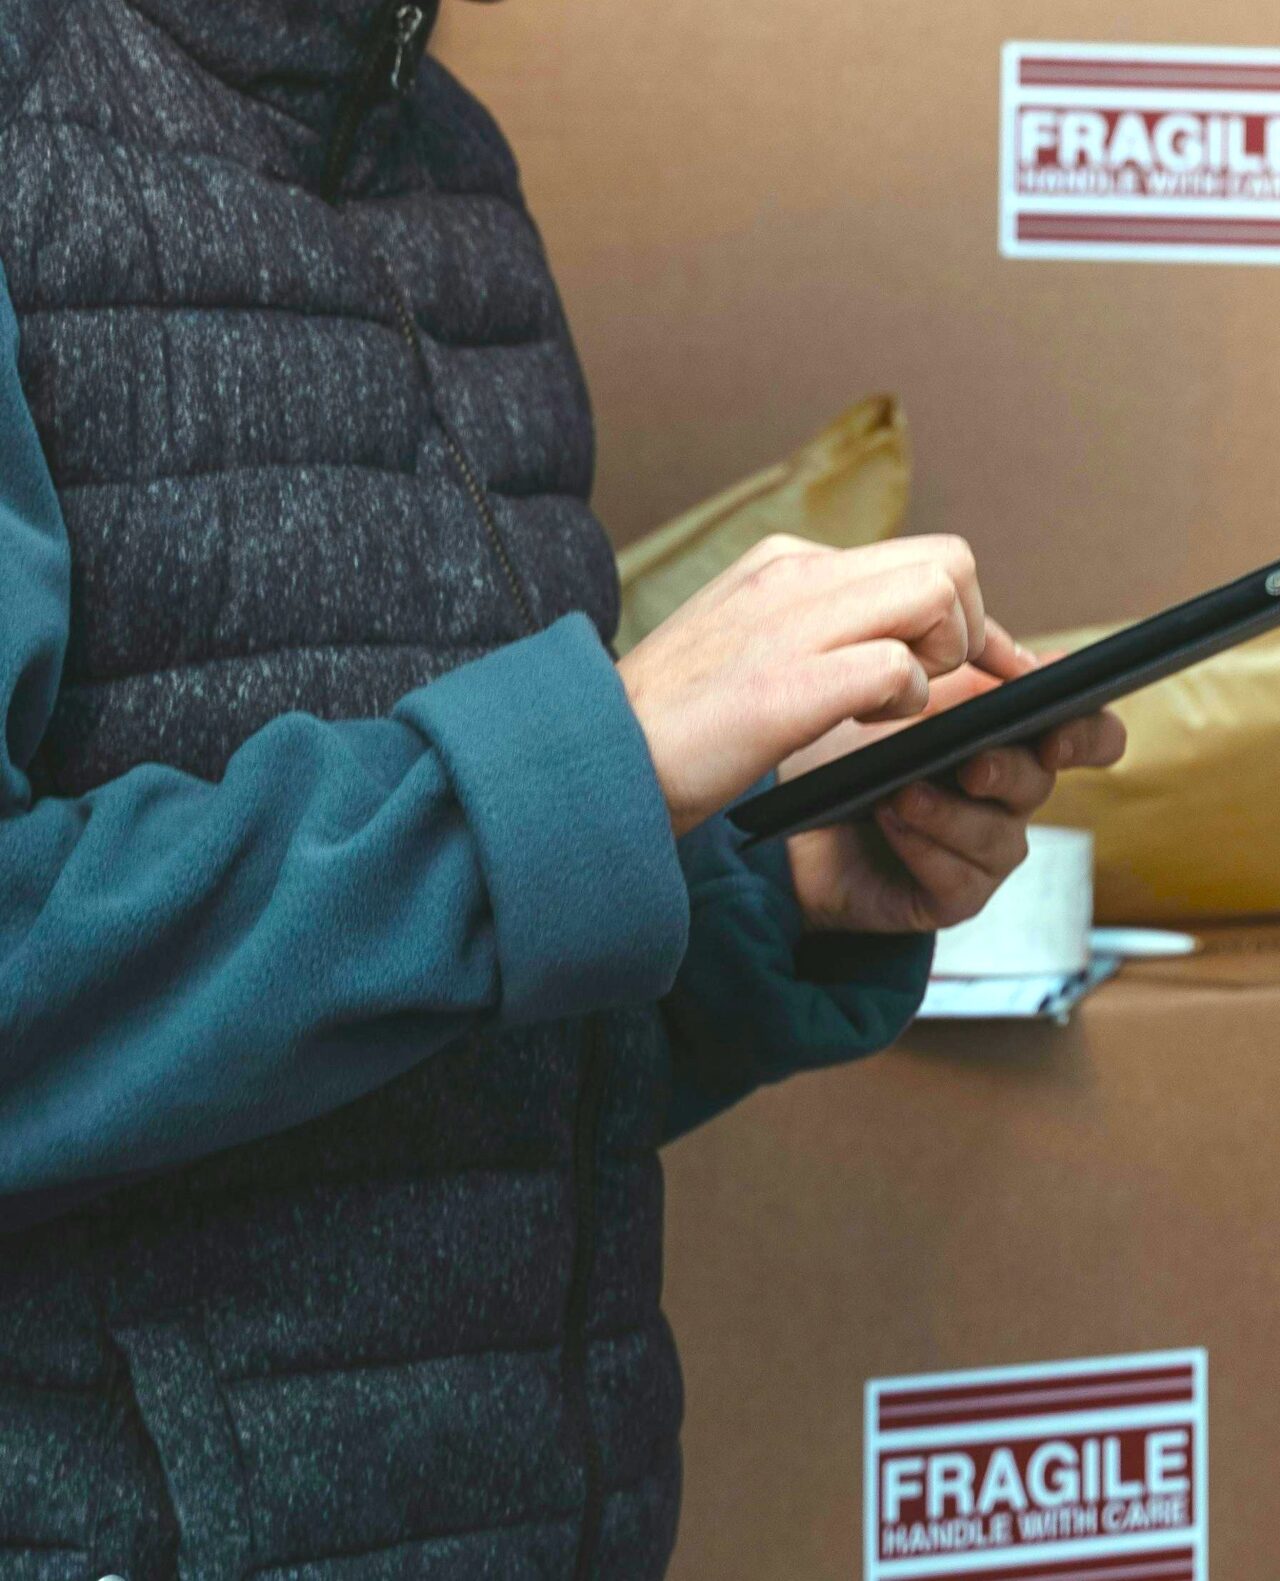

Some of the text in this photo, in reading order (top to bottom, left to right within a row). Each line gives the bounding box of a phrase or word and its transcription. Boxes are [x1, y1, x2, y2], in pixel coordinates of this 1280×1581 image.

[881, 1430, 1190, 1524] FRAGILE
[882, 1491, 1188, 1556] HANDLE WITH CARE
